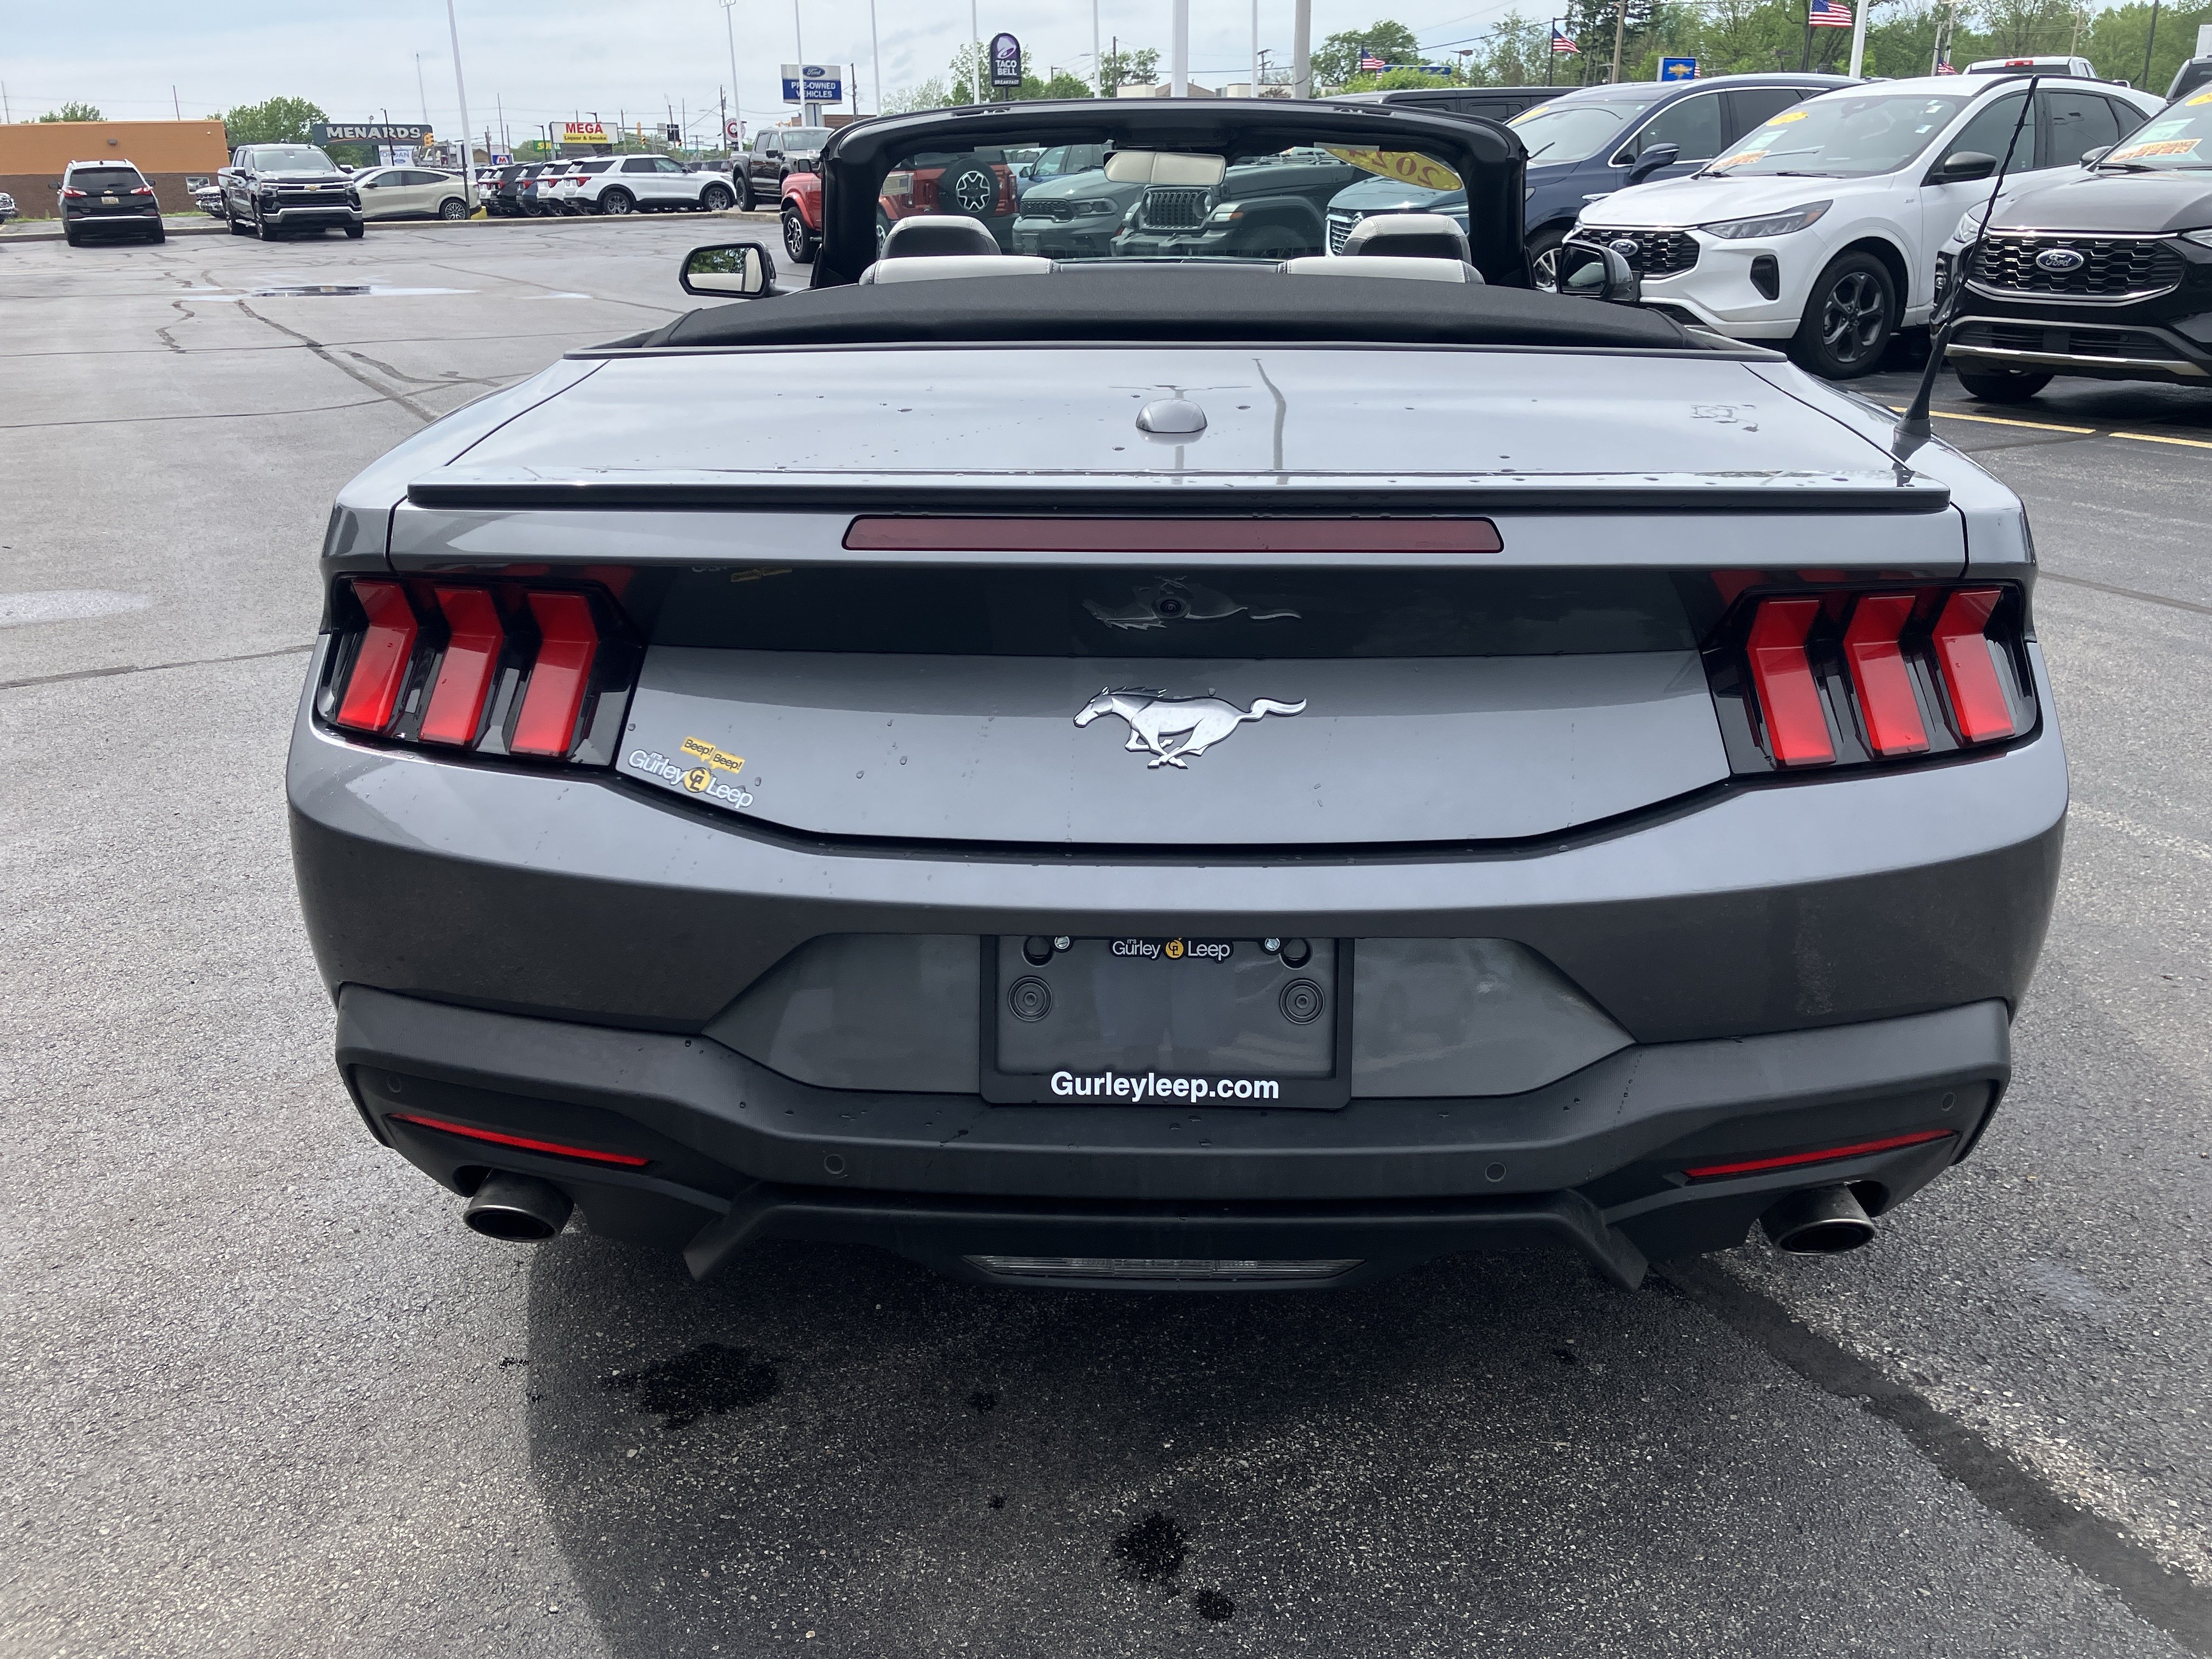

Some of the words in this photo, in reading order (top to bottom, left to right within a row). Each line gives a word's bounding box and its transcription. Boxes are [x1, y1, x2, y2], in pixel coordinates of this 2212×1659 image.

[326, 127, 421, 139] MENARDS
[566, 123, 603, 133] MEGA
[2045, 254, 2072, 267] Ford
[684, 739, 714, 756] Beep!
[713, 754, 742, 770] Beep!
[629, 749, 689, 785] Gurley
[706, 777, 754, 809] Leep
[1112, 940, 1161, 959] Gurley
[1188, 940, 1231, 961] Leep
[1051, 1071, 1279, 1102] Gurleyleep.com
